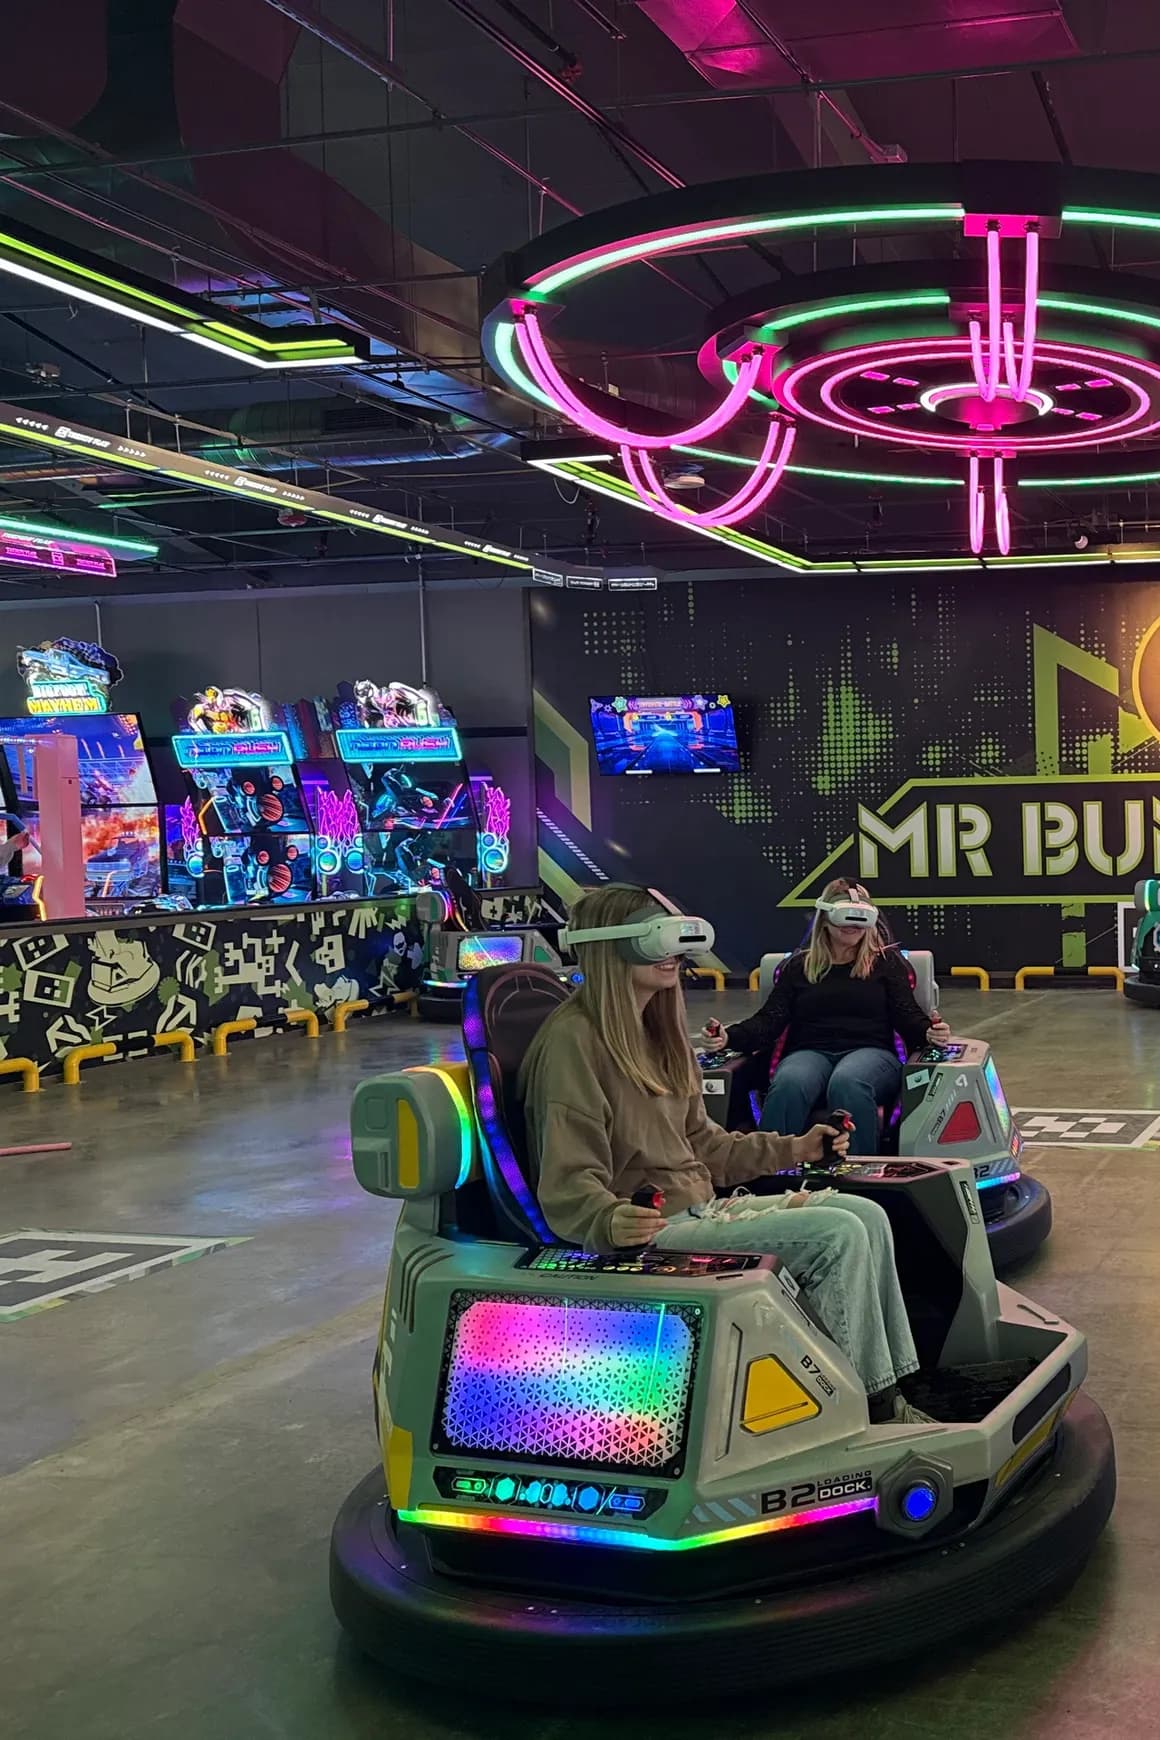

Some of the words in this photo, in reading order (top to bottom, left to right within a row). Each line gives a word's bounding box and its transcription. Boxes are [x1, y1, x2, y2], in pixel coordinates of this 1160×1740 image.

[28, 698, 98, 713] MAYHEM
[858, 800, 993, 878] MR
[800, 1354, 821, 1374] B7
[817, 1470, 872, 1487] LOADING
[761, 1483, 816, 1514] B2
[819, 1480, 872, 1499] DOCK.
